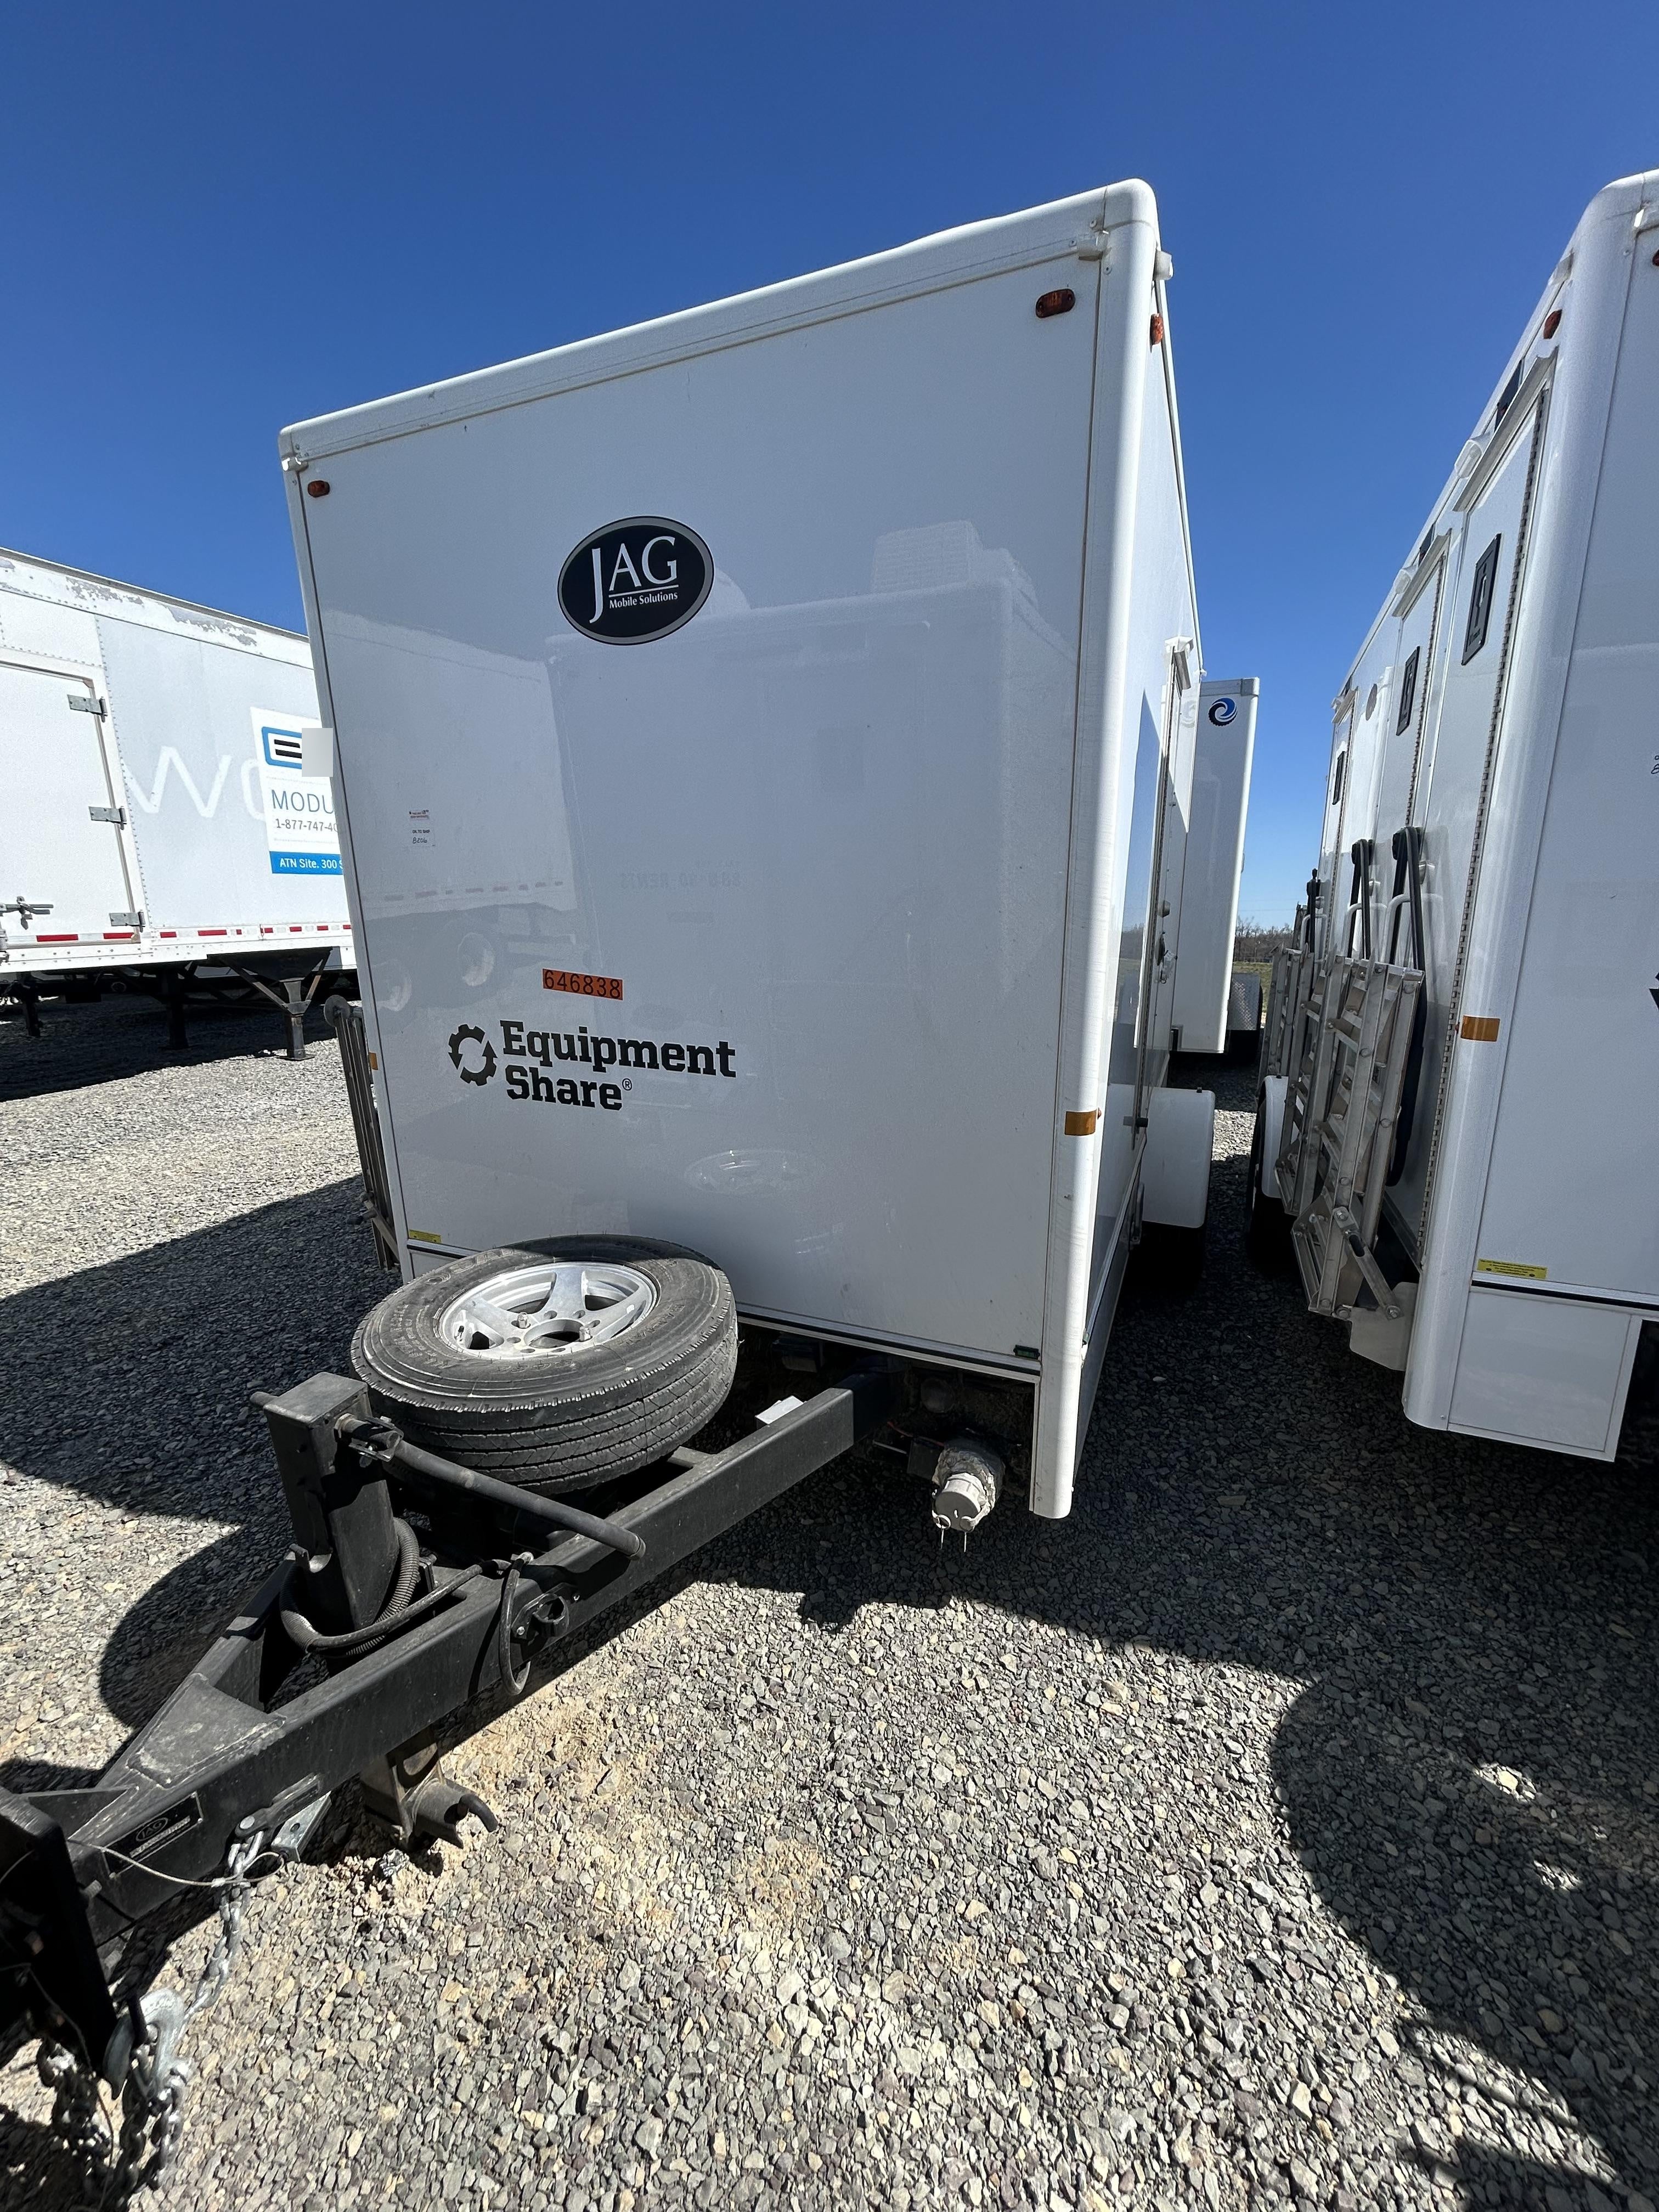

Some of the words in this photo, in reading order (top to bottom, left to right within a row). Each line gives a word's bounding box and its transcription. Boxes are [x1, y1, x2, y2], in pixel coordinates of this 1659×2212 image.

[589, 535, 677, 623] JAG
[609, 596, 637, 609] Mobile
[639, 591, 678, 605] Solutions
[280, 858, 297, 868] ATN
[321, 860, 337, 869] 300
[544, 969, 620, 998] 646838
[499, 1019, 736, 1077] Equipment
